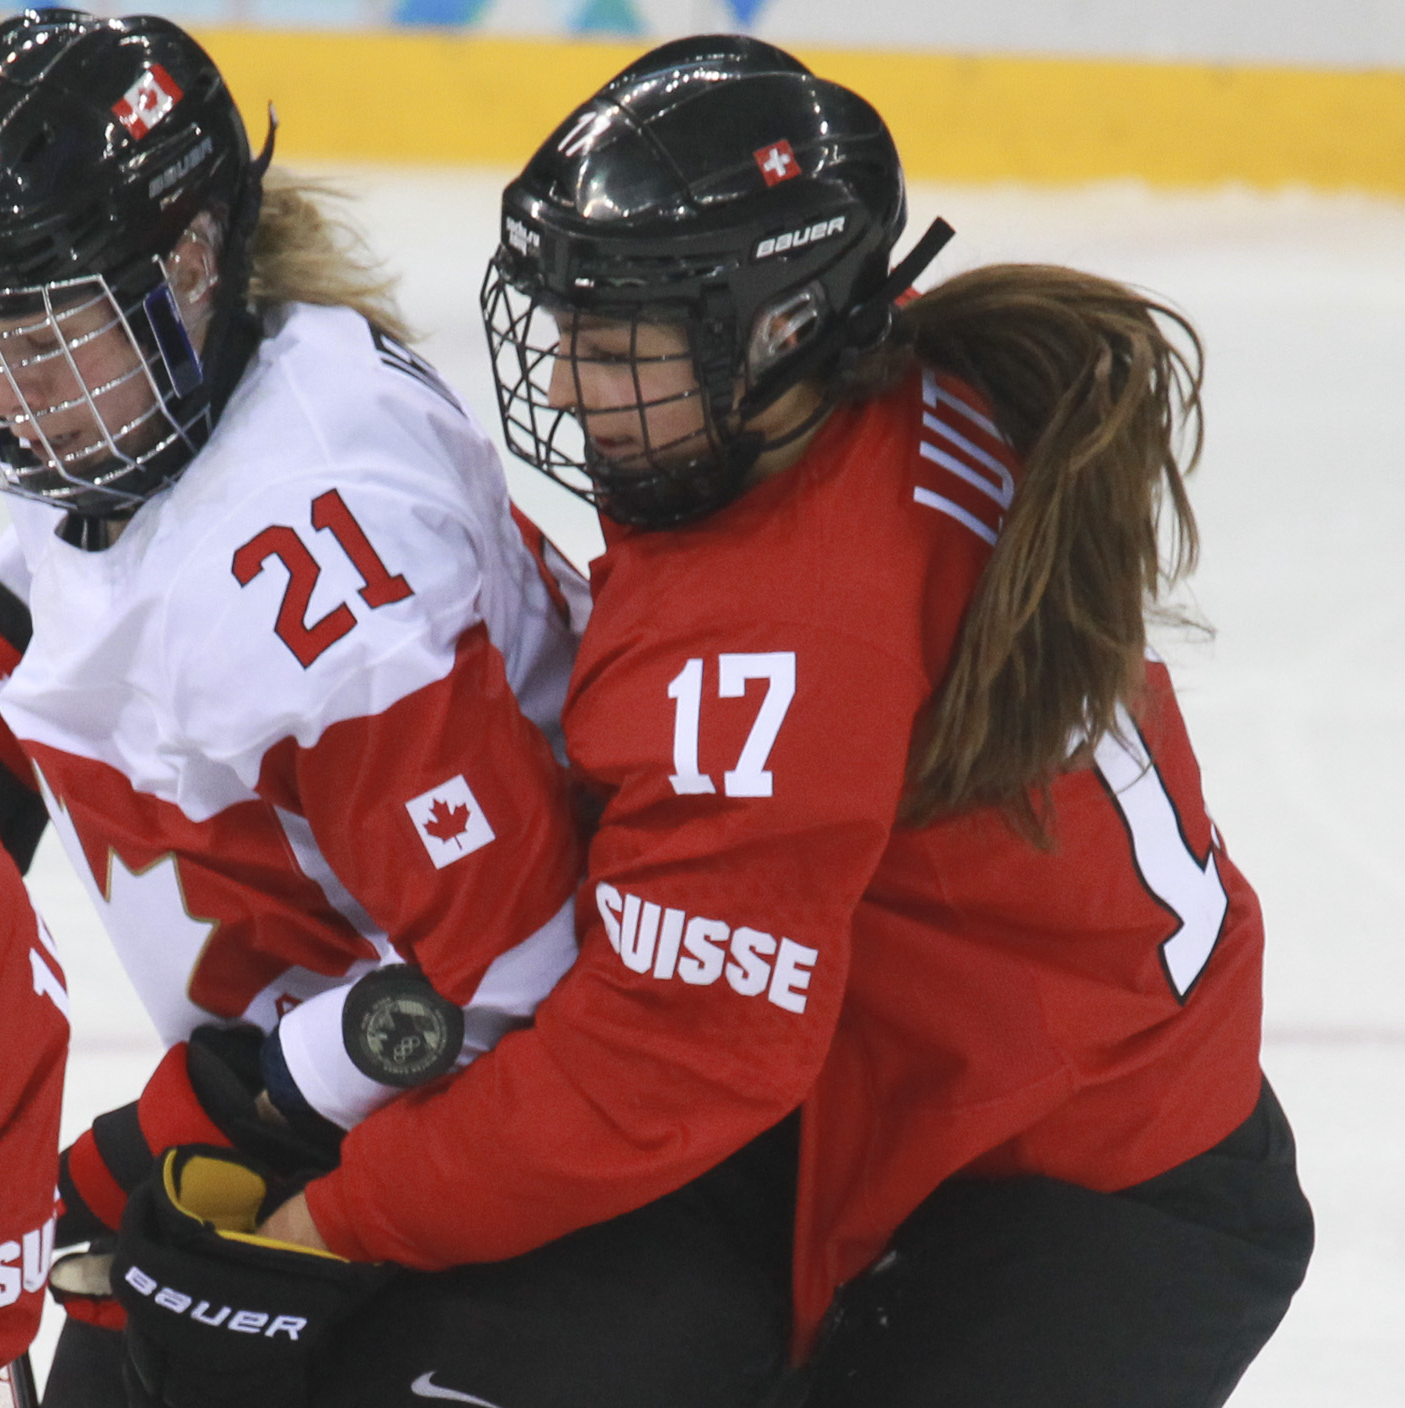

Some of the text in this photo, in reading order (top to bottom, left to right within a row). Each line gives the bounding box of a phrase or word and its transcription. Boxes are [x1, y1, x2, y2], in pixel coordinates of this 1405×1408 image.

[231, 488, 415, 669] 21
[667, 651, 796, 798] 17
[596, 882, 818, 1014] SUISSE
